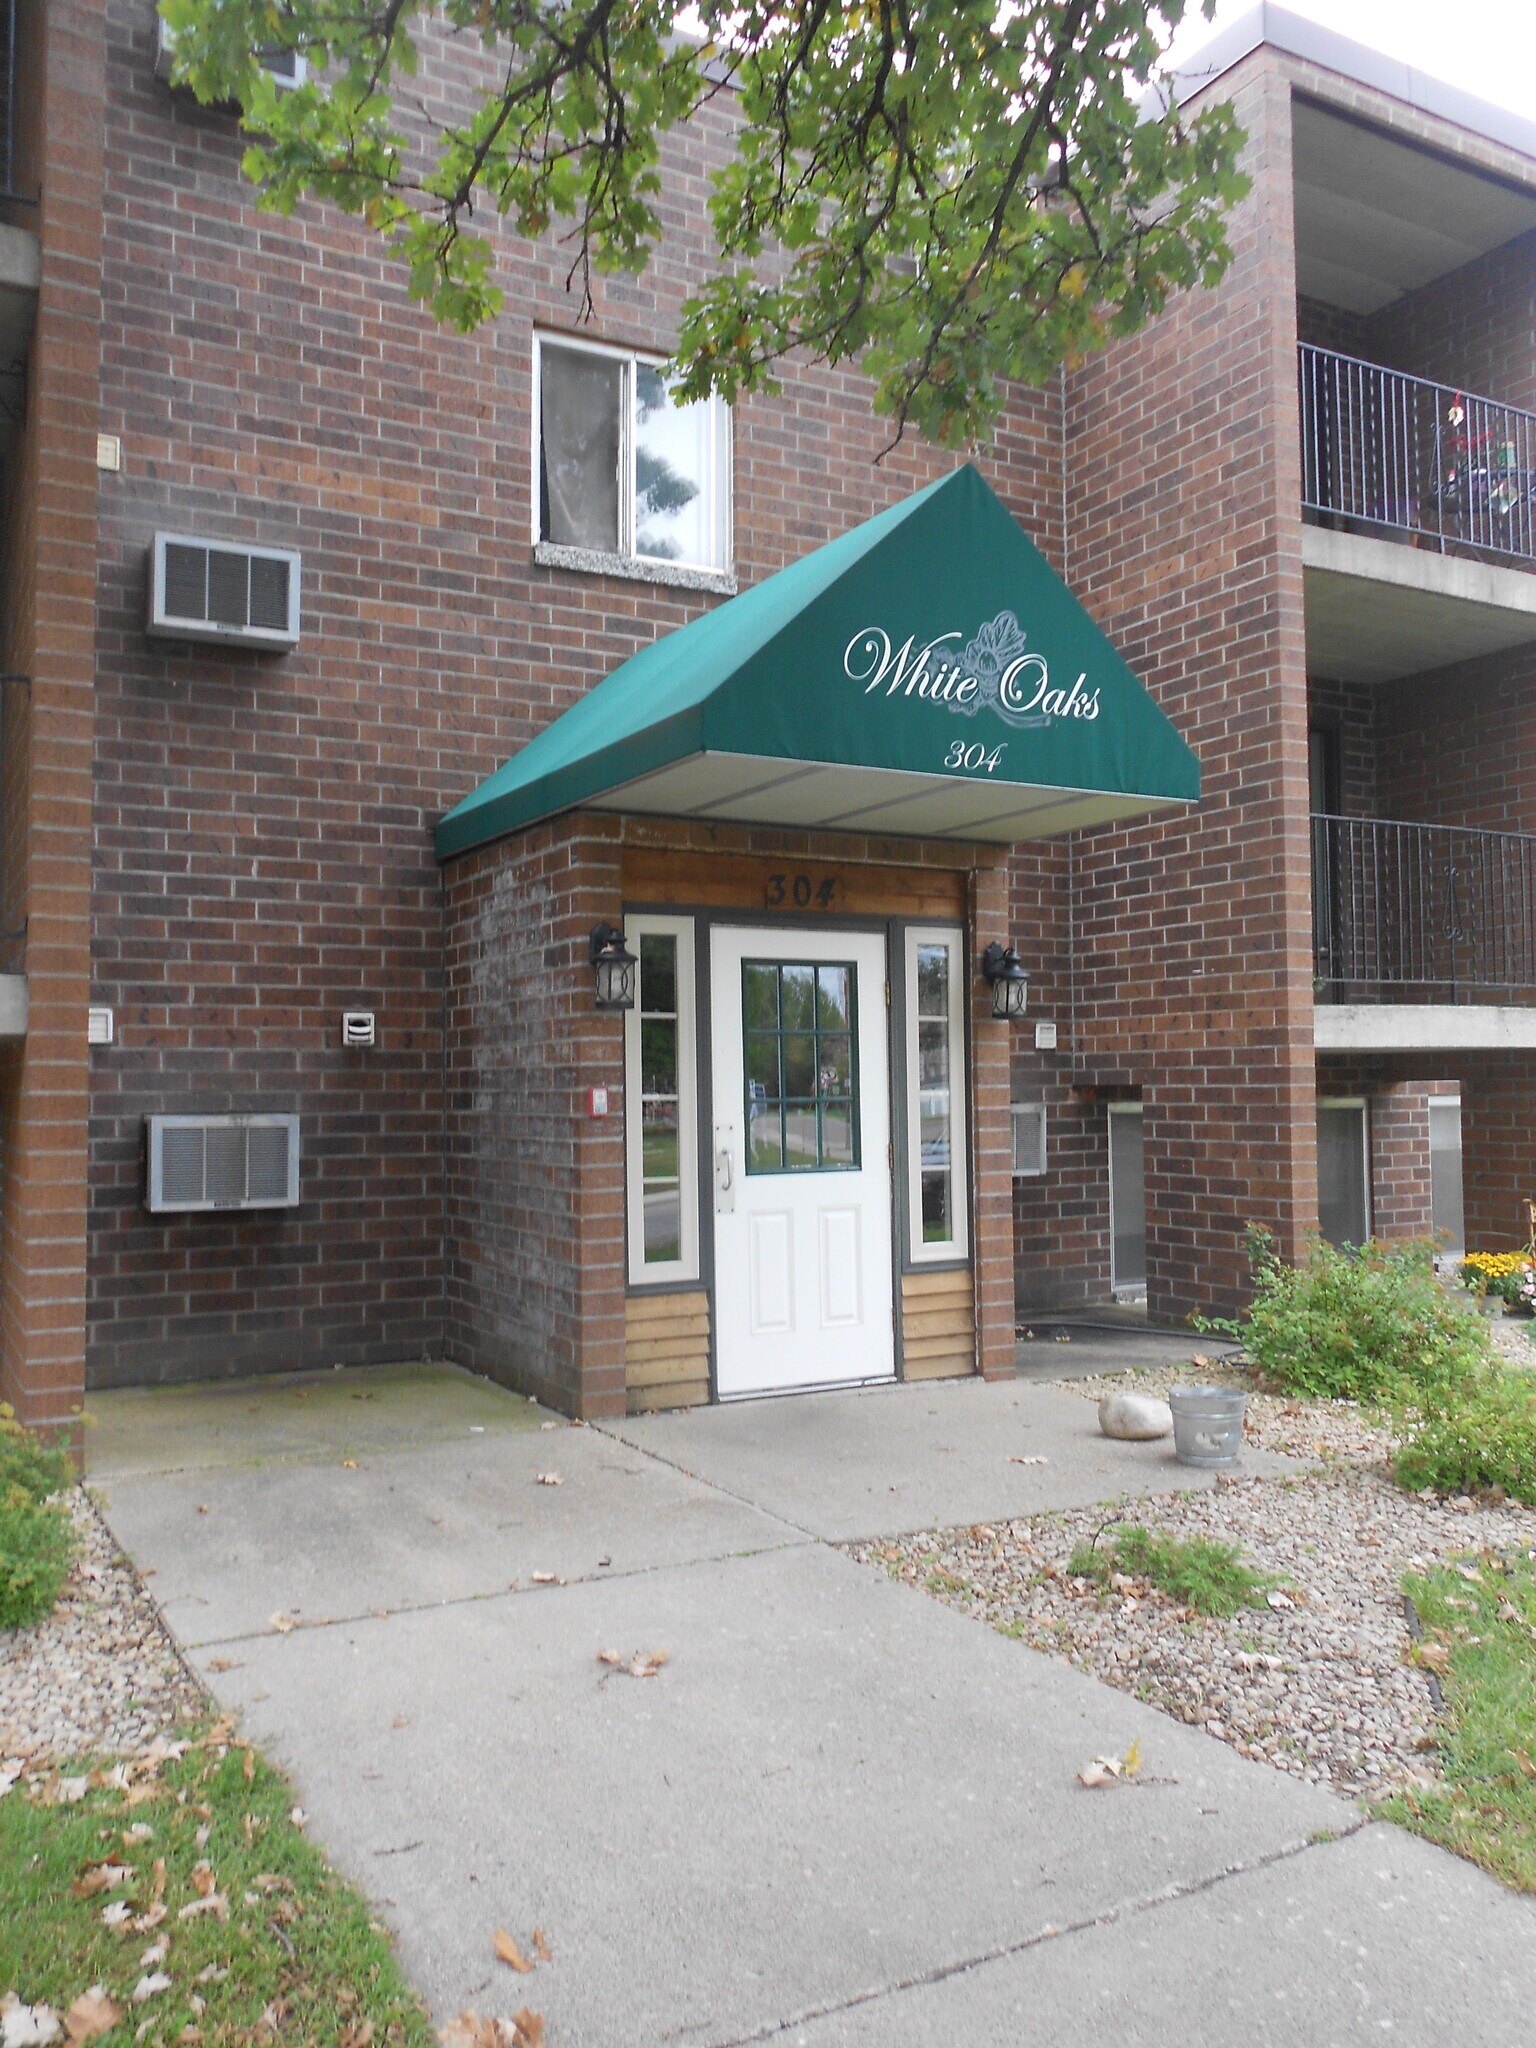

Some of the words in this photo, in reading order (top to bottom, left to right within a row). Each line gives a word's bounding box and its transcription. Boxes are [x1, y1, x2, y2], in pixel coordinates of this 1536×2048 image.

[844, 626, 979, 703] White
[1000, 653, 1101, 721] Oaks
[944, 740, 1009, 772] 304
[766, 873, 837, 908] 304
